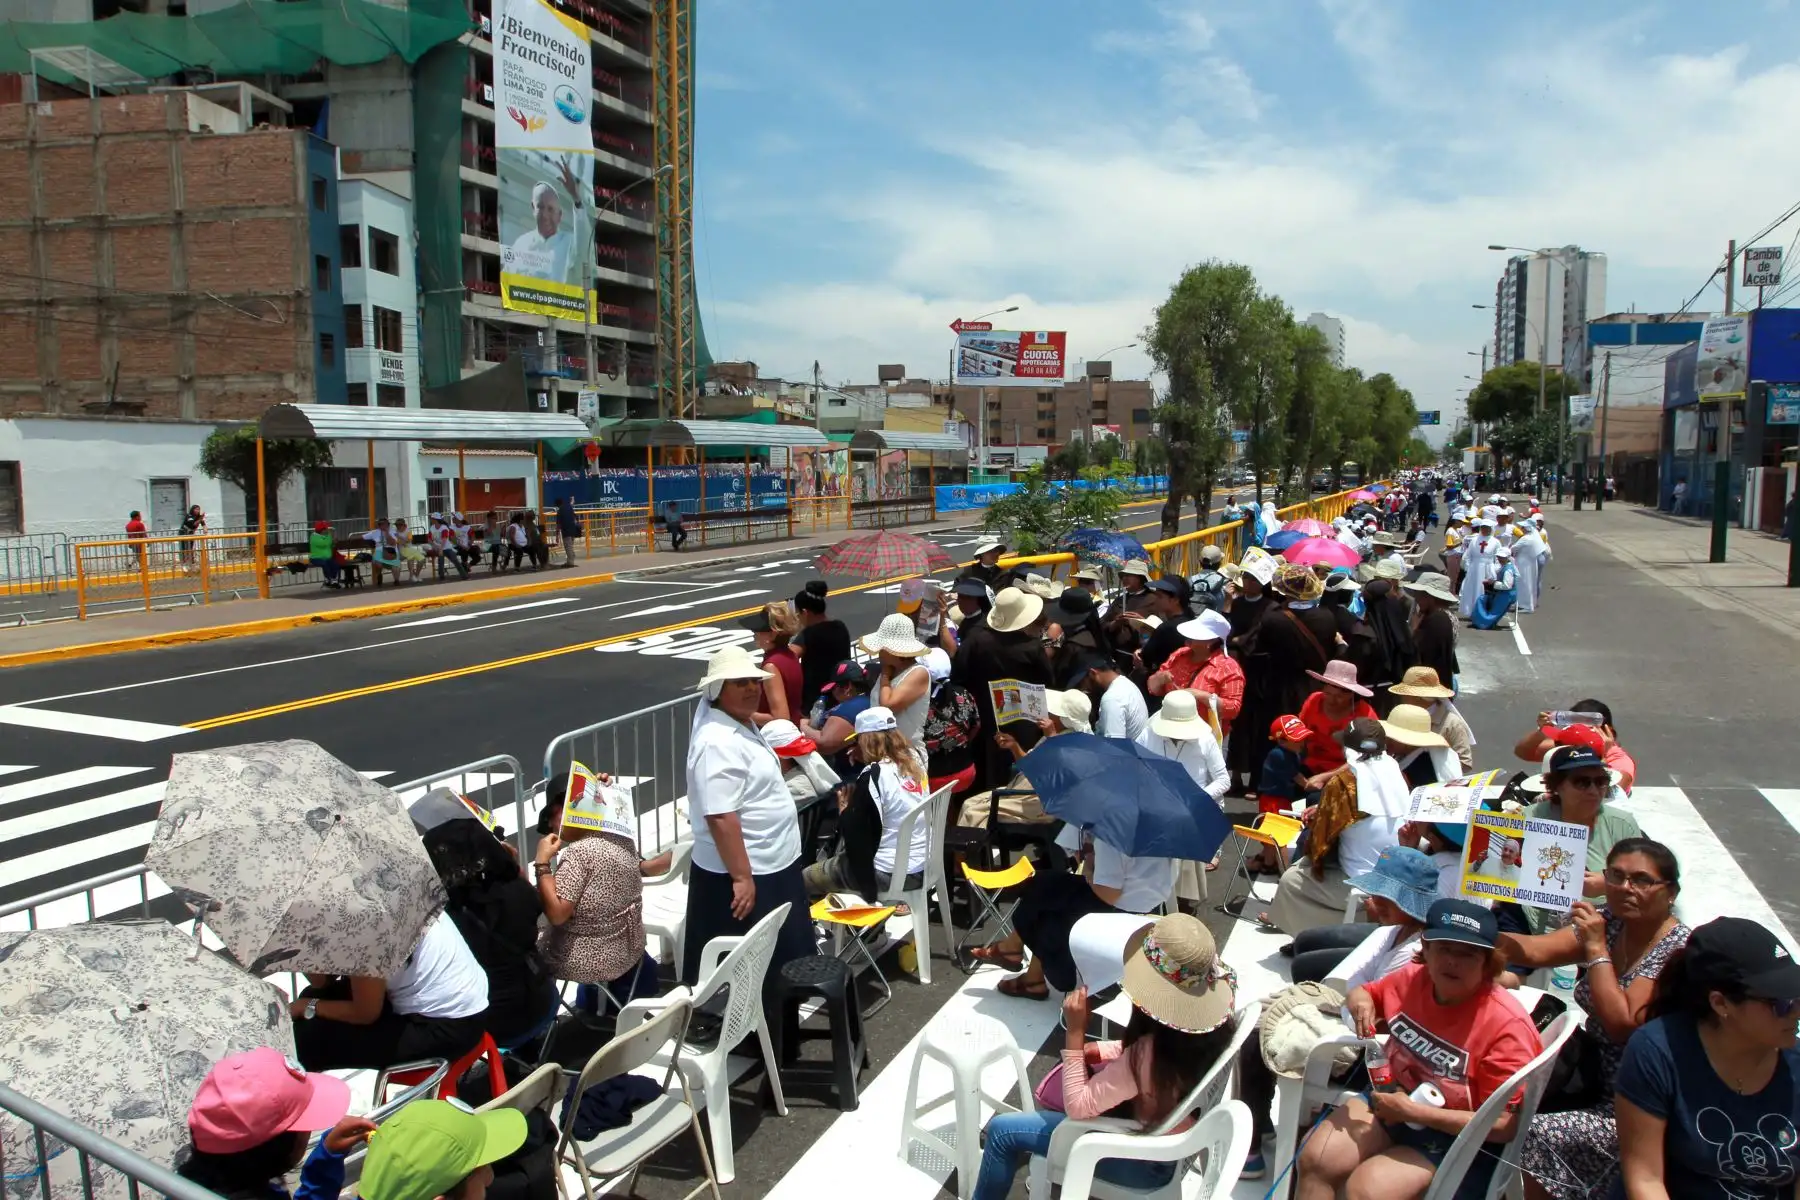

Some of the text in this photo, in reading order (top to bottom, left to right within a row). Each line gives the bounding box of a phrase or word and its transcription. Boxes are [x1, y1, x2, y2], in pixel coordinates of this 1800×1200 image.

[500, 13, 585, 66] ¡Bienvenido
[501, 34, 576, 80] Francisco!
[503, 59, 524, 73] PAPA
[503, 69, 547, 91] FRANCISCO
[503, 78, 544, 99] LIMA 2018
[1746, 248, 1781, 260] Cambio
[1757, 261, 1770, 272] de
[1746, 272, 1780, 285] Aceite
[965, 323, 990, 331] cuadras
[1023, 350, 1058, 360] CUOTAS
[381, 356, 403, 370] VENDE
[1023, 366, 1057, 375] POR UN AÑO
[1474, 813, 1587, 840] BIENVENIDO PAPA FRANCISCO AL PERÚ
[1472, 881, 1511, 897] BENDICENOS
[1512, 887, 1532, 901] AMIGO
[1533, 890, 1570, 908] PEREGRINO
